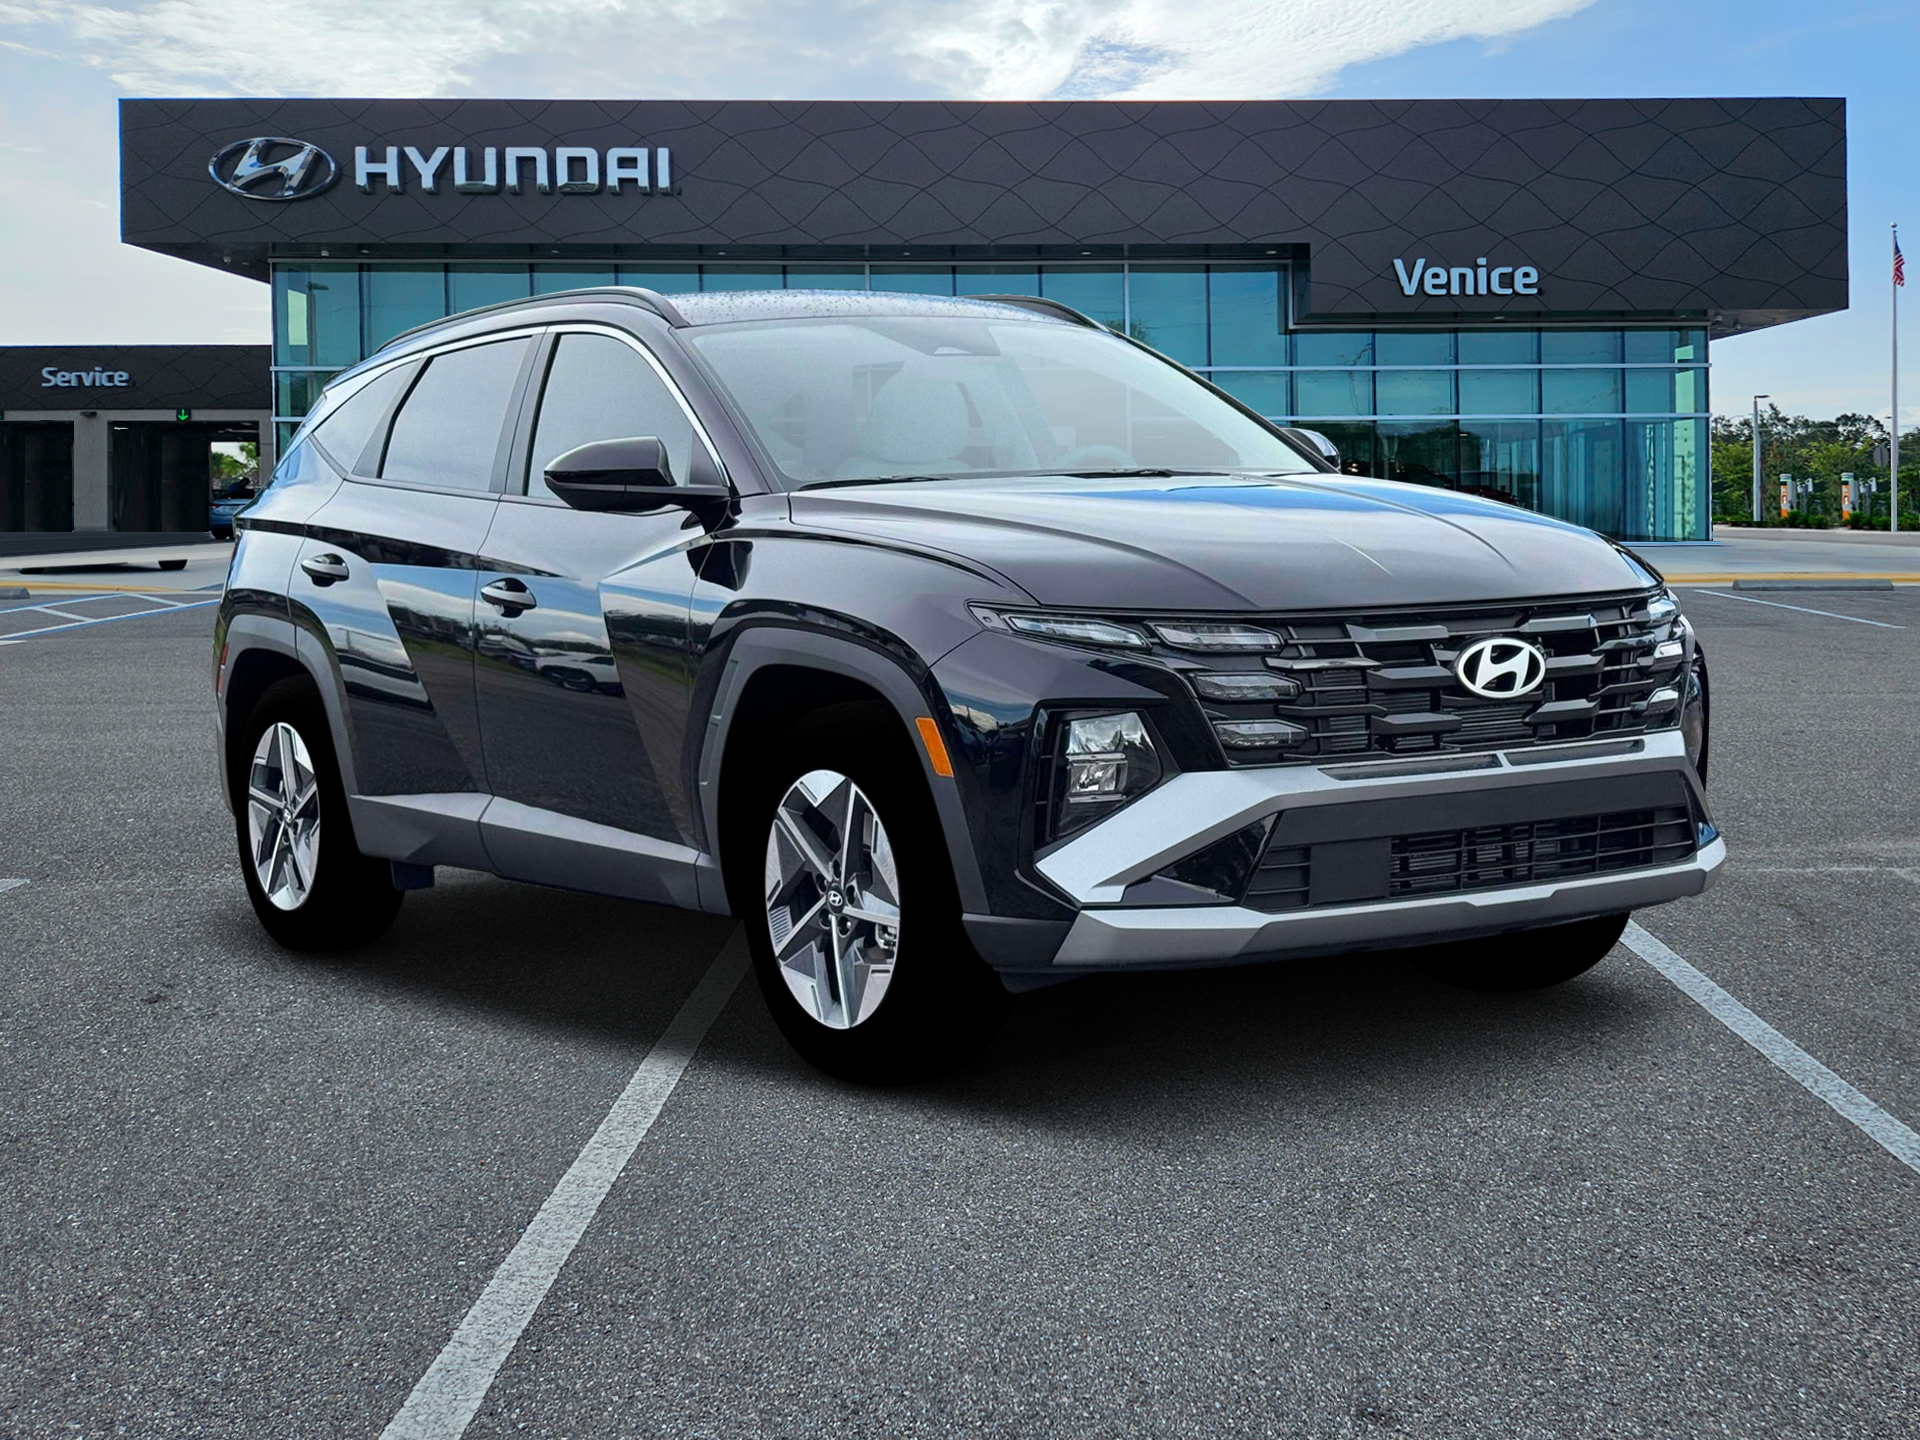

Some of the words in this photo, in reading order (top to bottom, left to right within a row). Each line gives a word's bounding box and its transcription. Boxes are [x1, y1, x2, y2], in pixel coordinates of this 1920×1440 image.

[354, 146, 672, 195] HYUNDAI
[1392, 257, 1539, 296] Venice
[41, 366, 130, 388] Service
